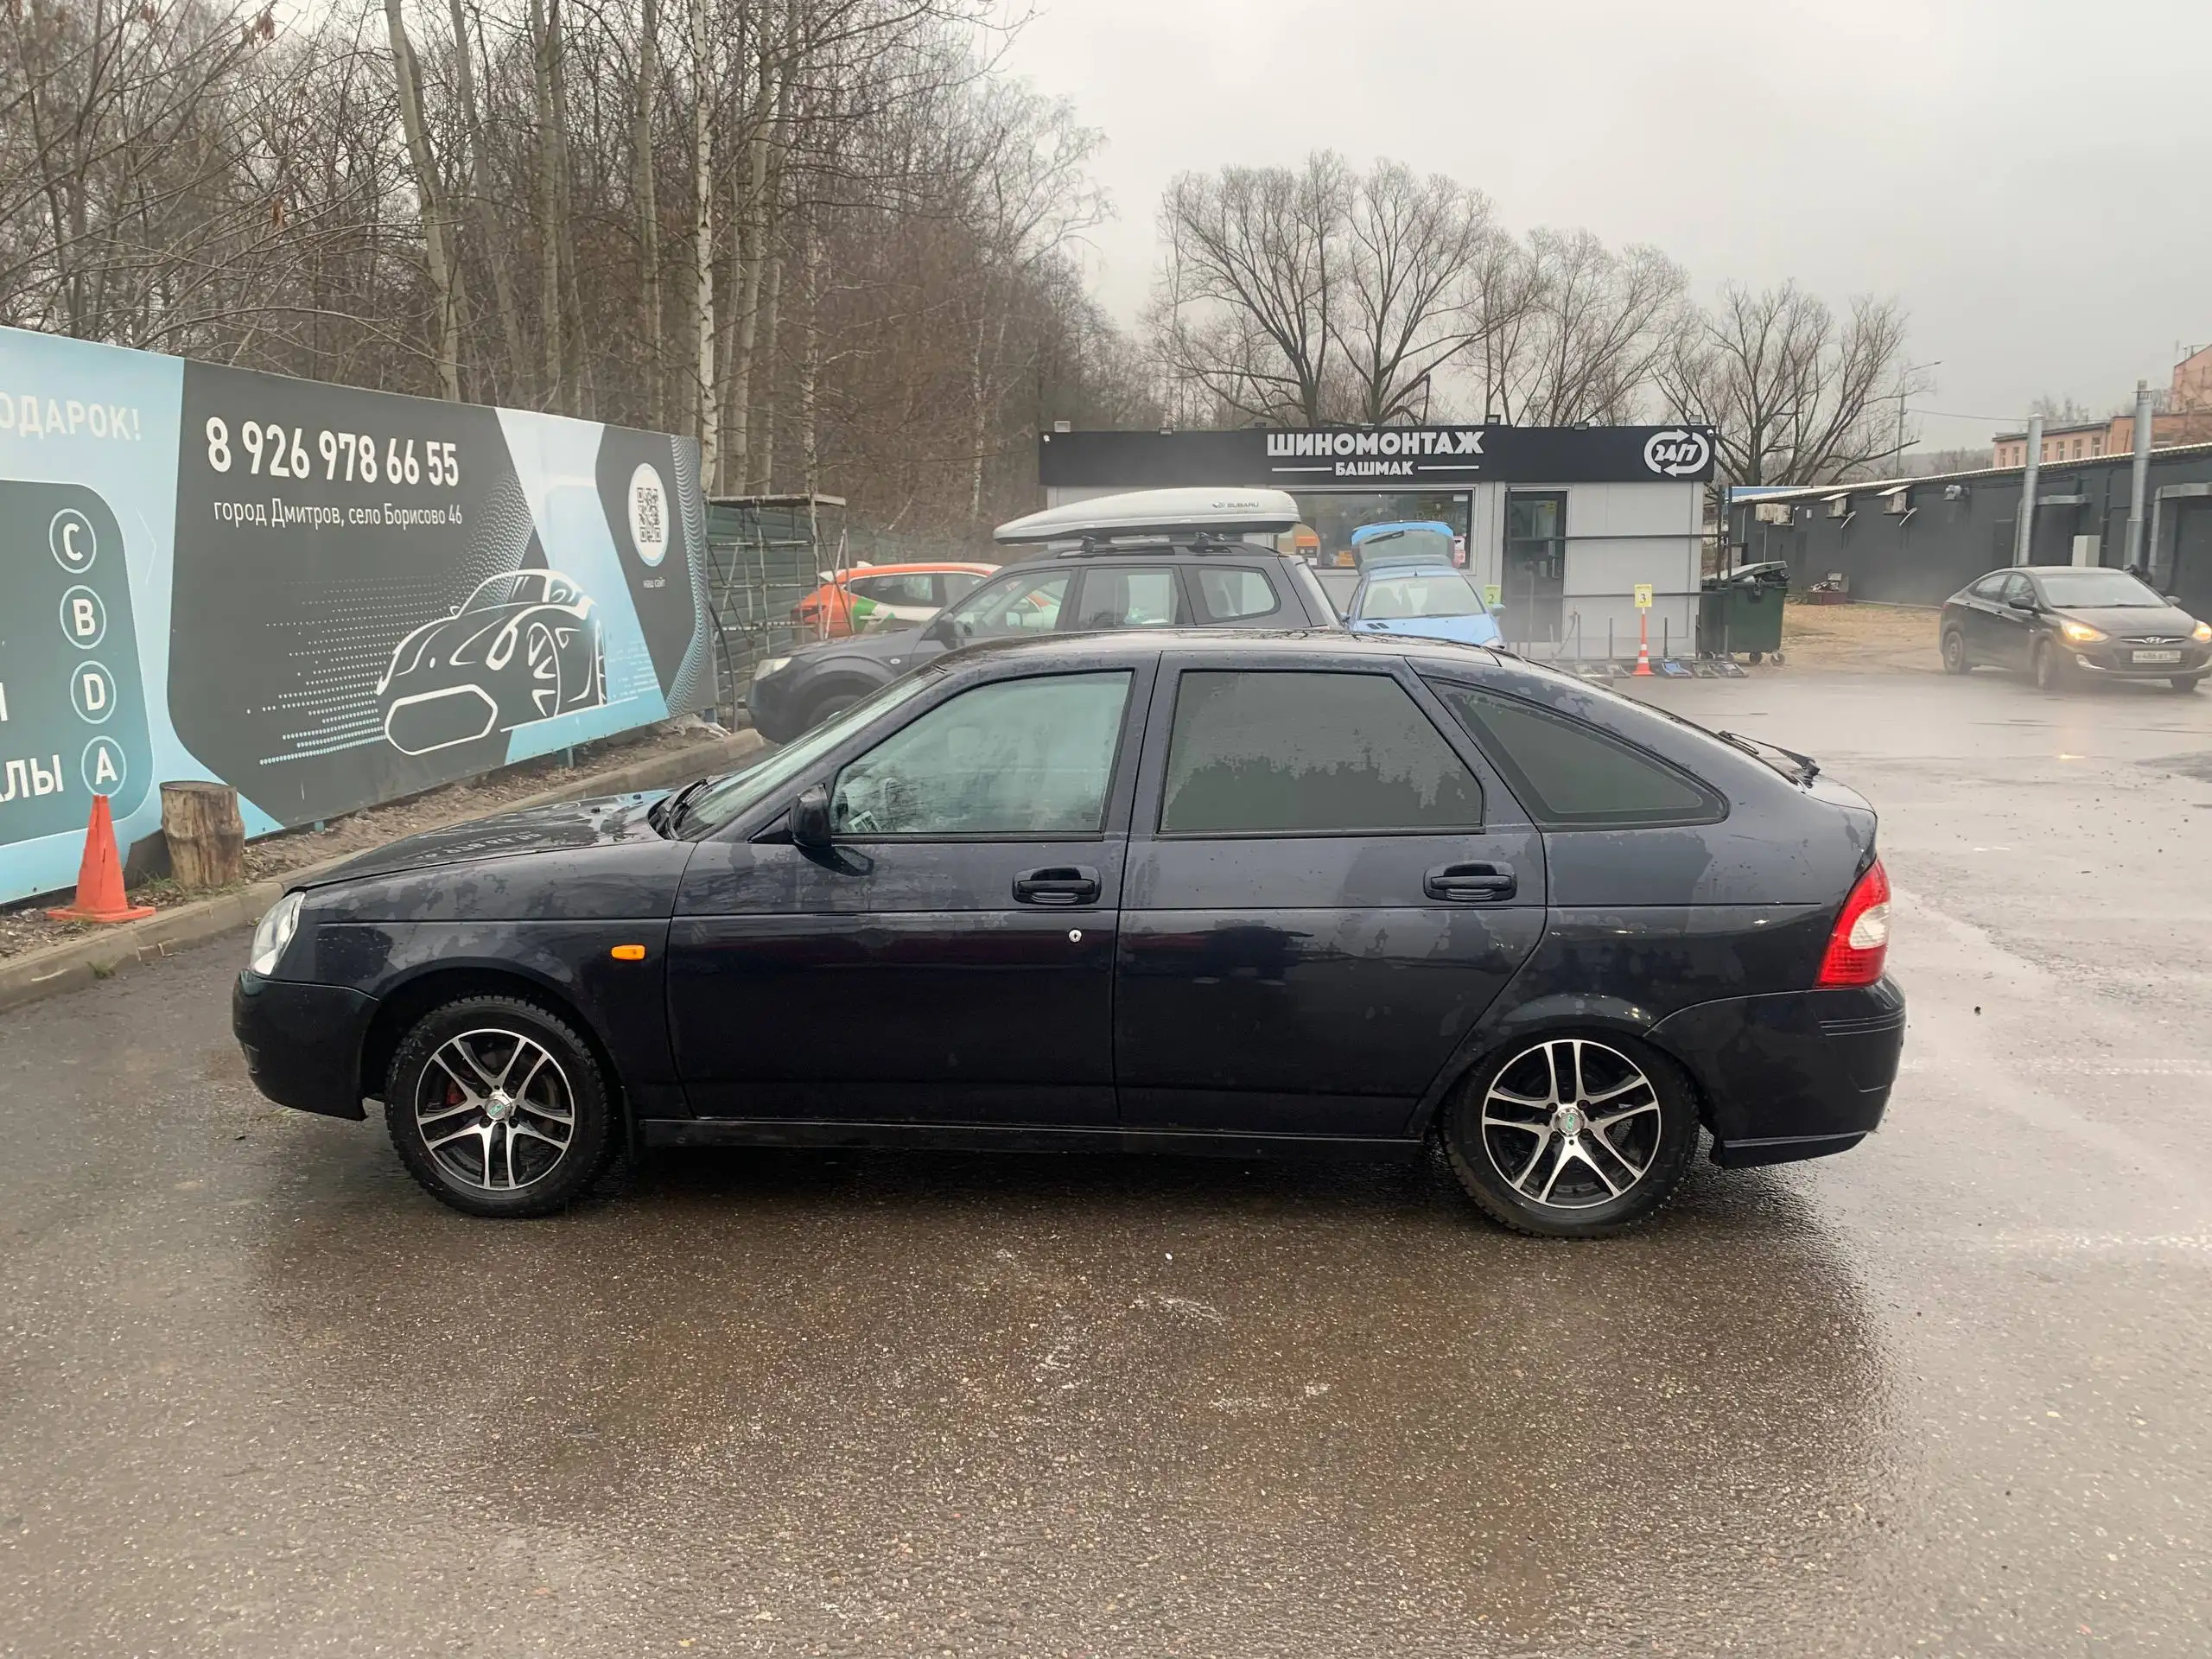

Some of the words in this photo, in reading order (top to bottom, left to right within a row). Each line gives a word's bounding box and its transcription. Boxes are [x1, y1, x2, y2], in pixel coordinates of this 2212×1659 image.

[206, 416, 232, 473] 8
[242, 421, 310, 479] 926
[319, 430, 378, 483] 978
[386, 438, 420, 485] 66
[426, 441, 459, 486] 55
[1267, 431, 1484, 456] ШИНОМОНТАЖ
[1654, 443, 1699, 462] 24/7
[1335, 461, 1414, 476] БАШМАК
[213, 501, 267, 528] город
[271, 498, 345, 530] Дмитров,
[348, 506, 381, 524] село
[384, 502, 446, 531] Борисово
[448, 504, 463, 524] 46
[63, 523, 84, 561] C
[73, 598, 96, 637] B
[83, 673, 105, 711] D
[0, 754, 64, 803] ЛЫ
[95, 747, 118, 785] A
